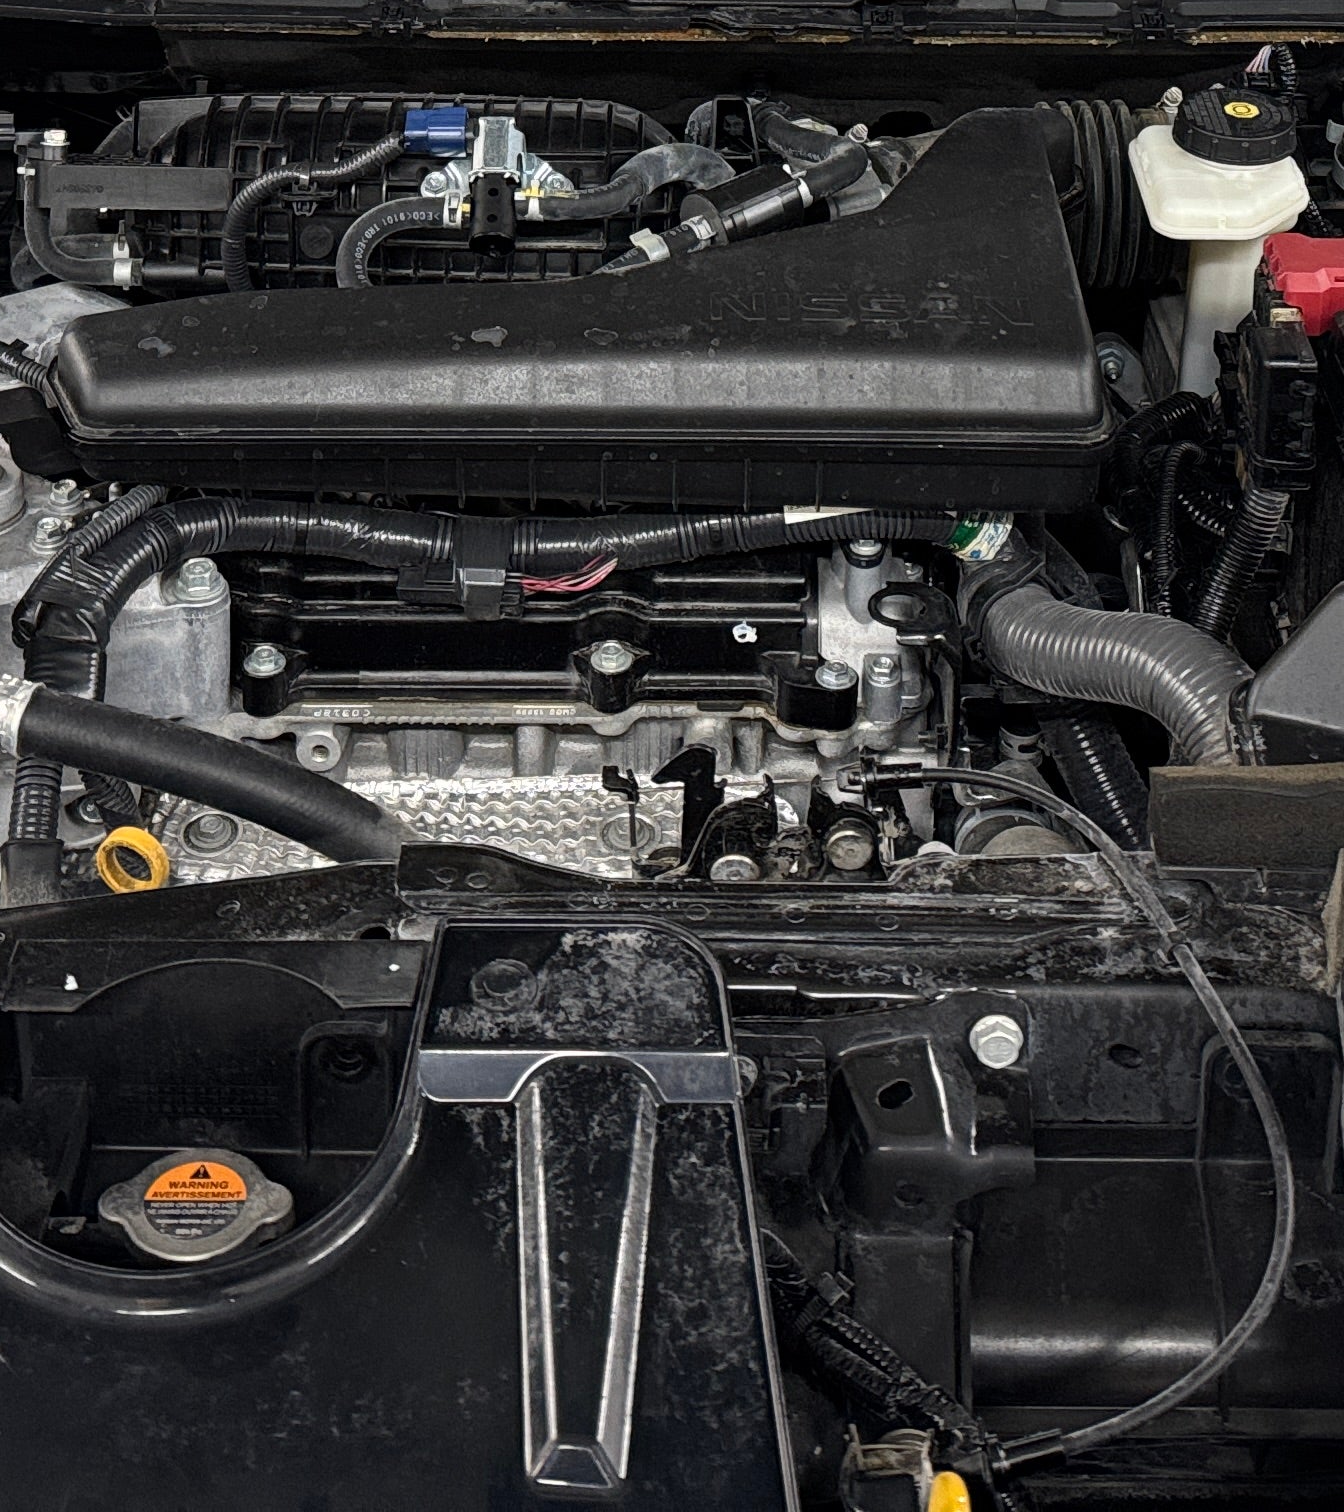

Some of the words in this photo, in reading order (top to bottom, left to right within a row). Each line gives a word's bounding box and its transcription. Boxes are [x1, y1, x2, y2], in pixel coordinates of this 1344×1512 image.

[709, 291, 1035, 326] NISSAN
[169, 1180, 229, 1190] WARNING
[151, 1191, 243, 1199] AVERTISSEMENT
